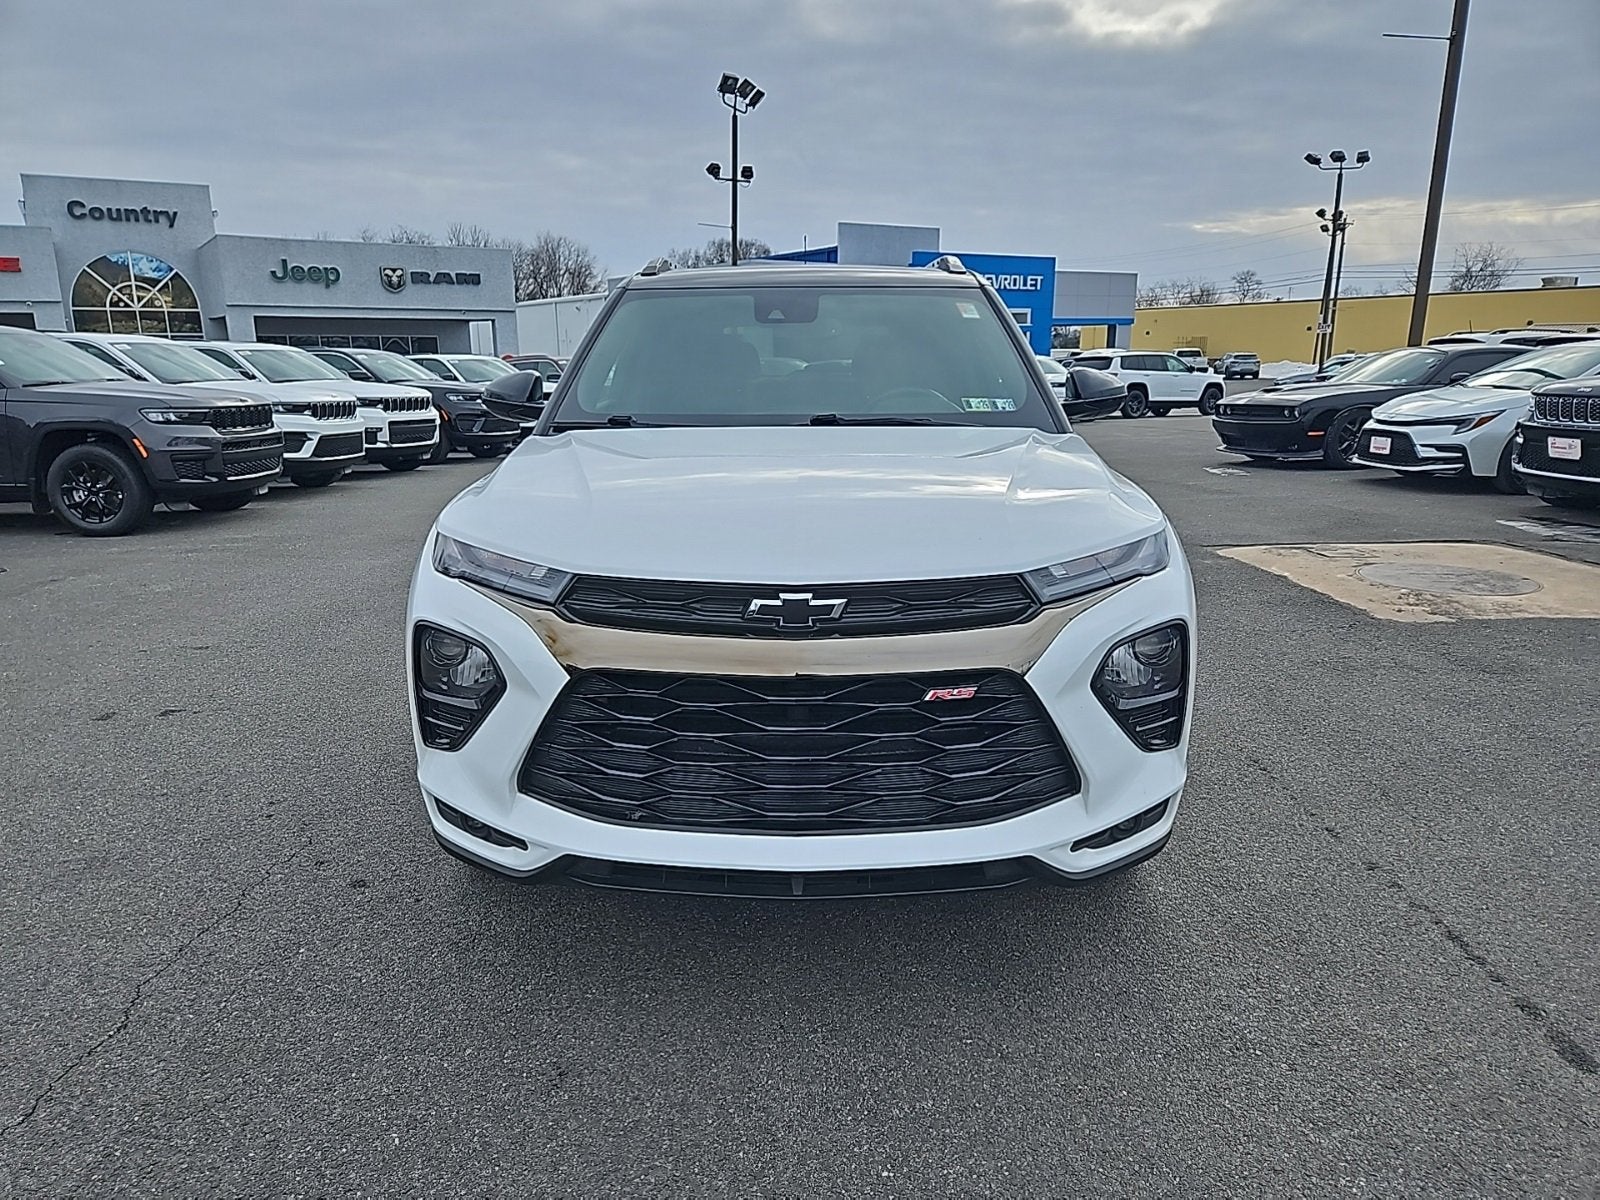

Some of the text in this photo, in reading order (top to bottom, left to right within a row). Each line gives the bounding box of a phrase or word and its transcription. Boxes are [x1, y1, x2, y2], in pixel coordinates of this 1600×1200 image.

[67, 200, 178, 229] Country
[270, 253, 341, 289] Jeep
[410, 271, 481, 285] RAM
[984, 274, 1044, 290] EVROLET
[924, 686, 978, 701] RS
